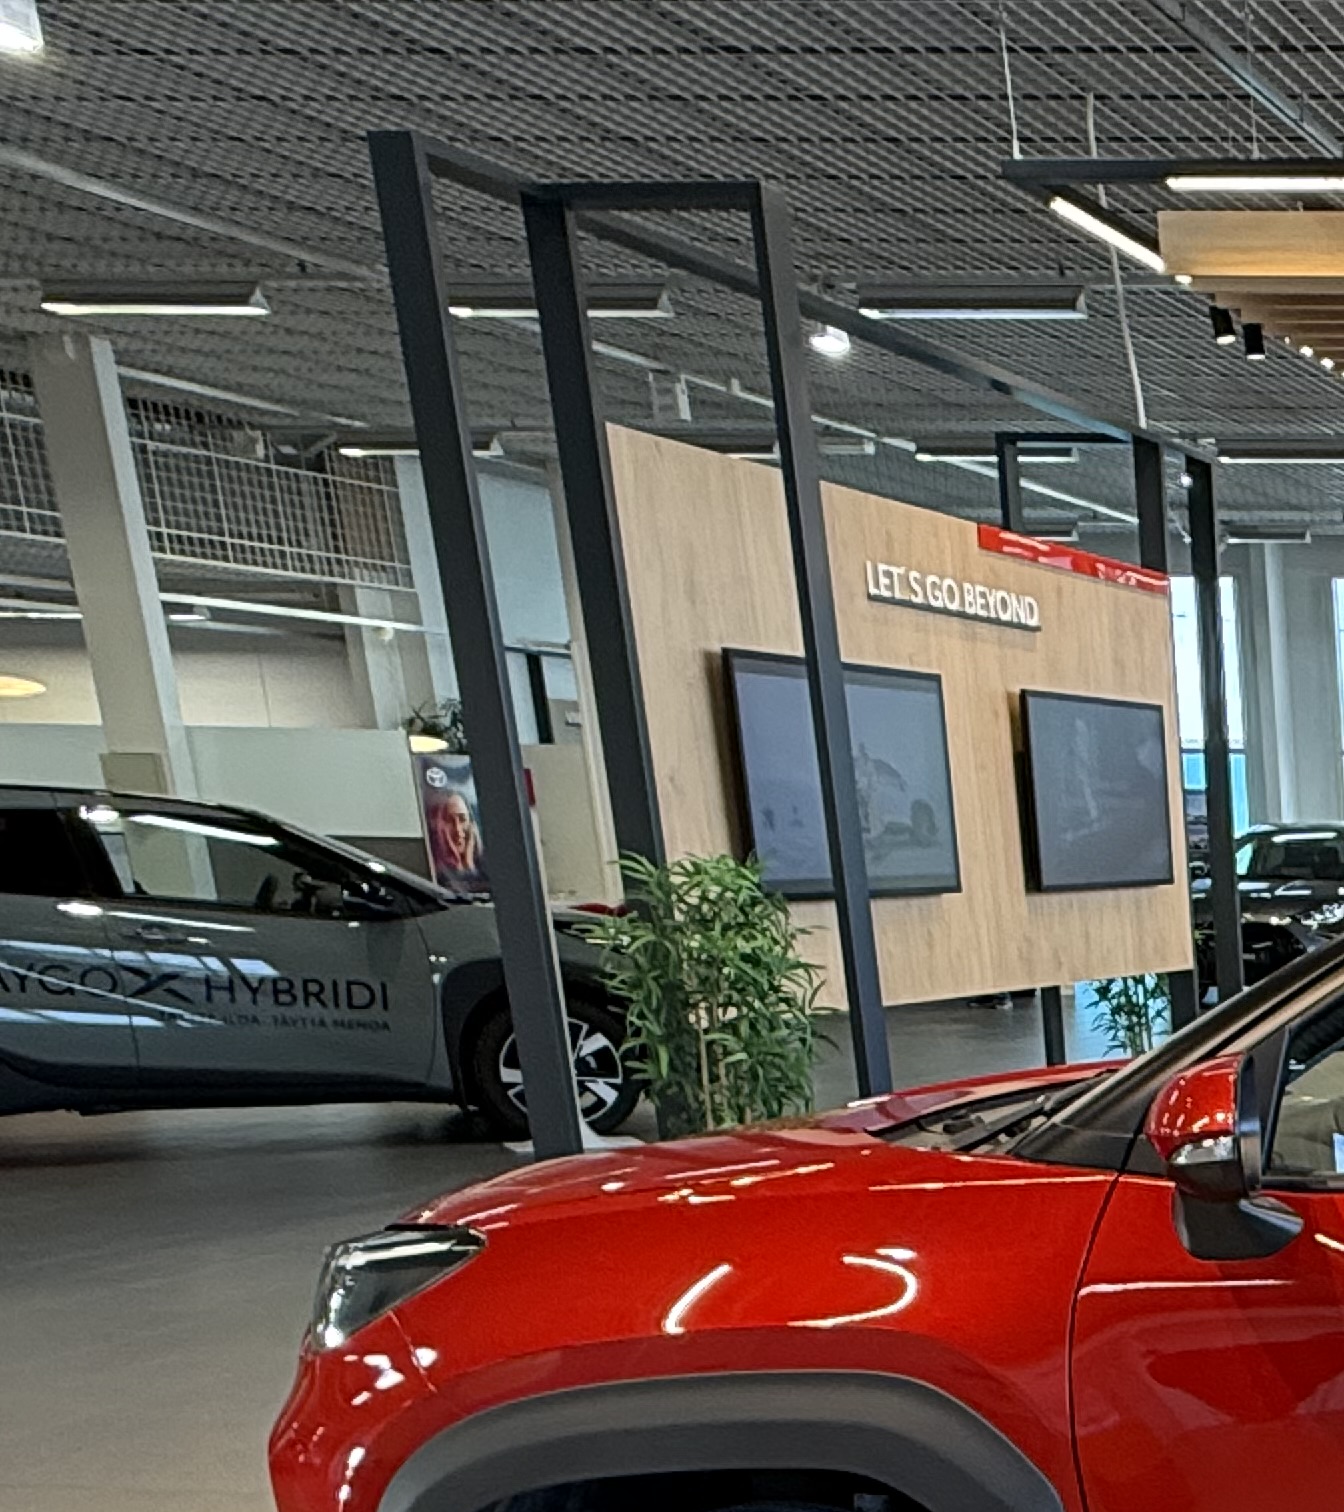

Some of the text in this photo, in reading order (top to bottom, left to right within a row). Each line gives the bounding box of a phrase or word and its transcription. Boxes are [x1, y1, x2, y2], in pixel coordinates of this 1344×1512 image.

[865, 560, 1040, 626] LET'S GO BEYOND
[204, 973, 391, 1012] HYBRIDI
